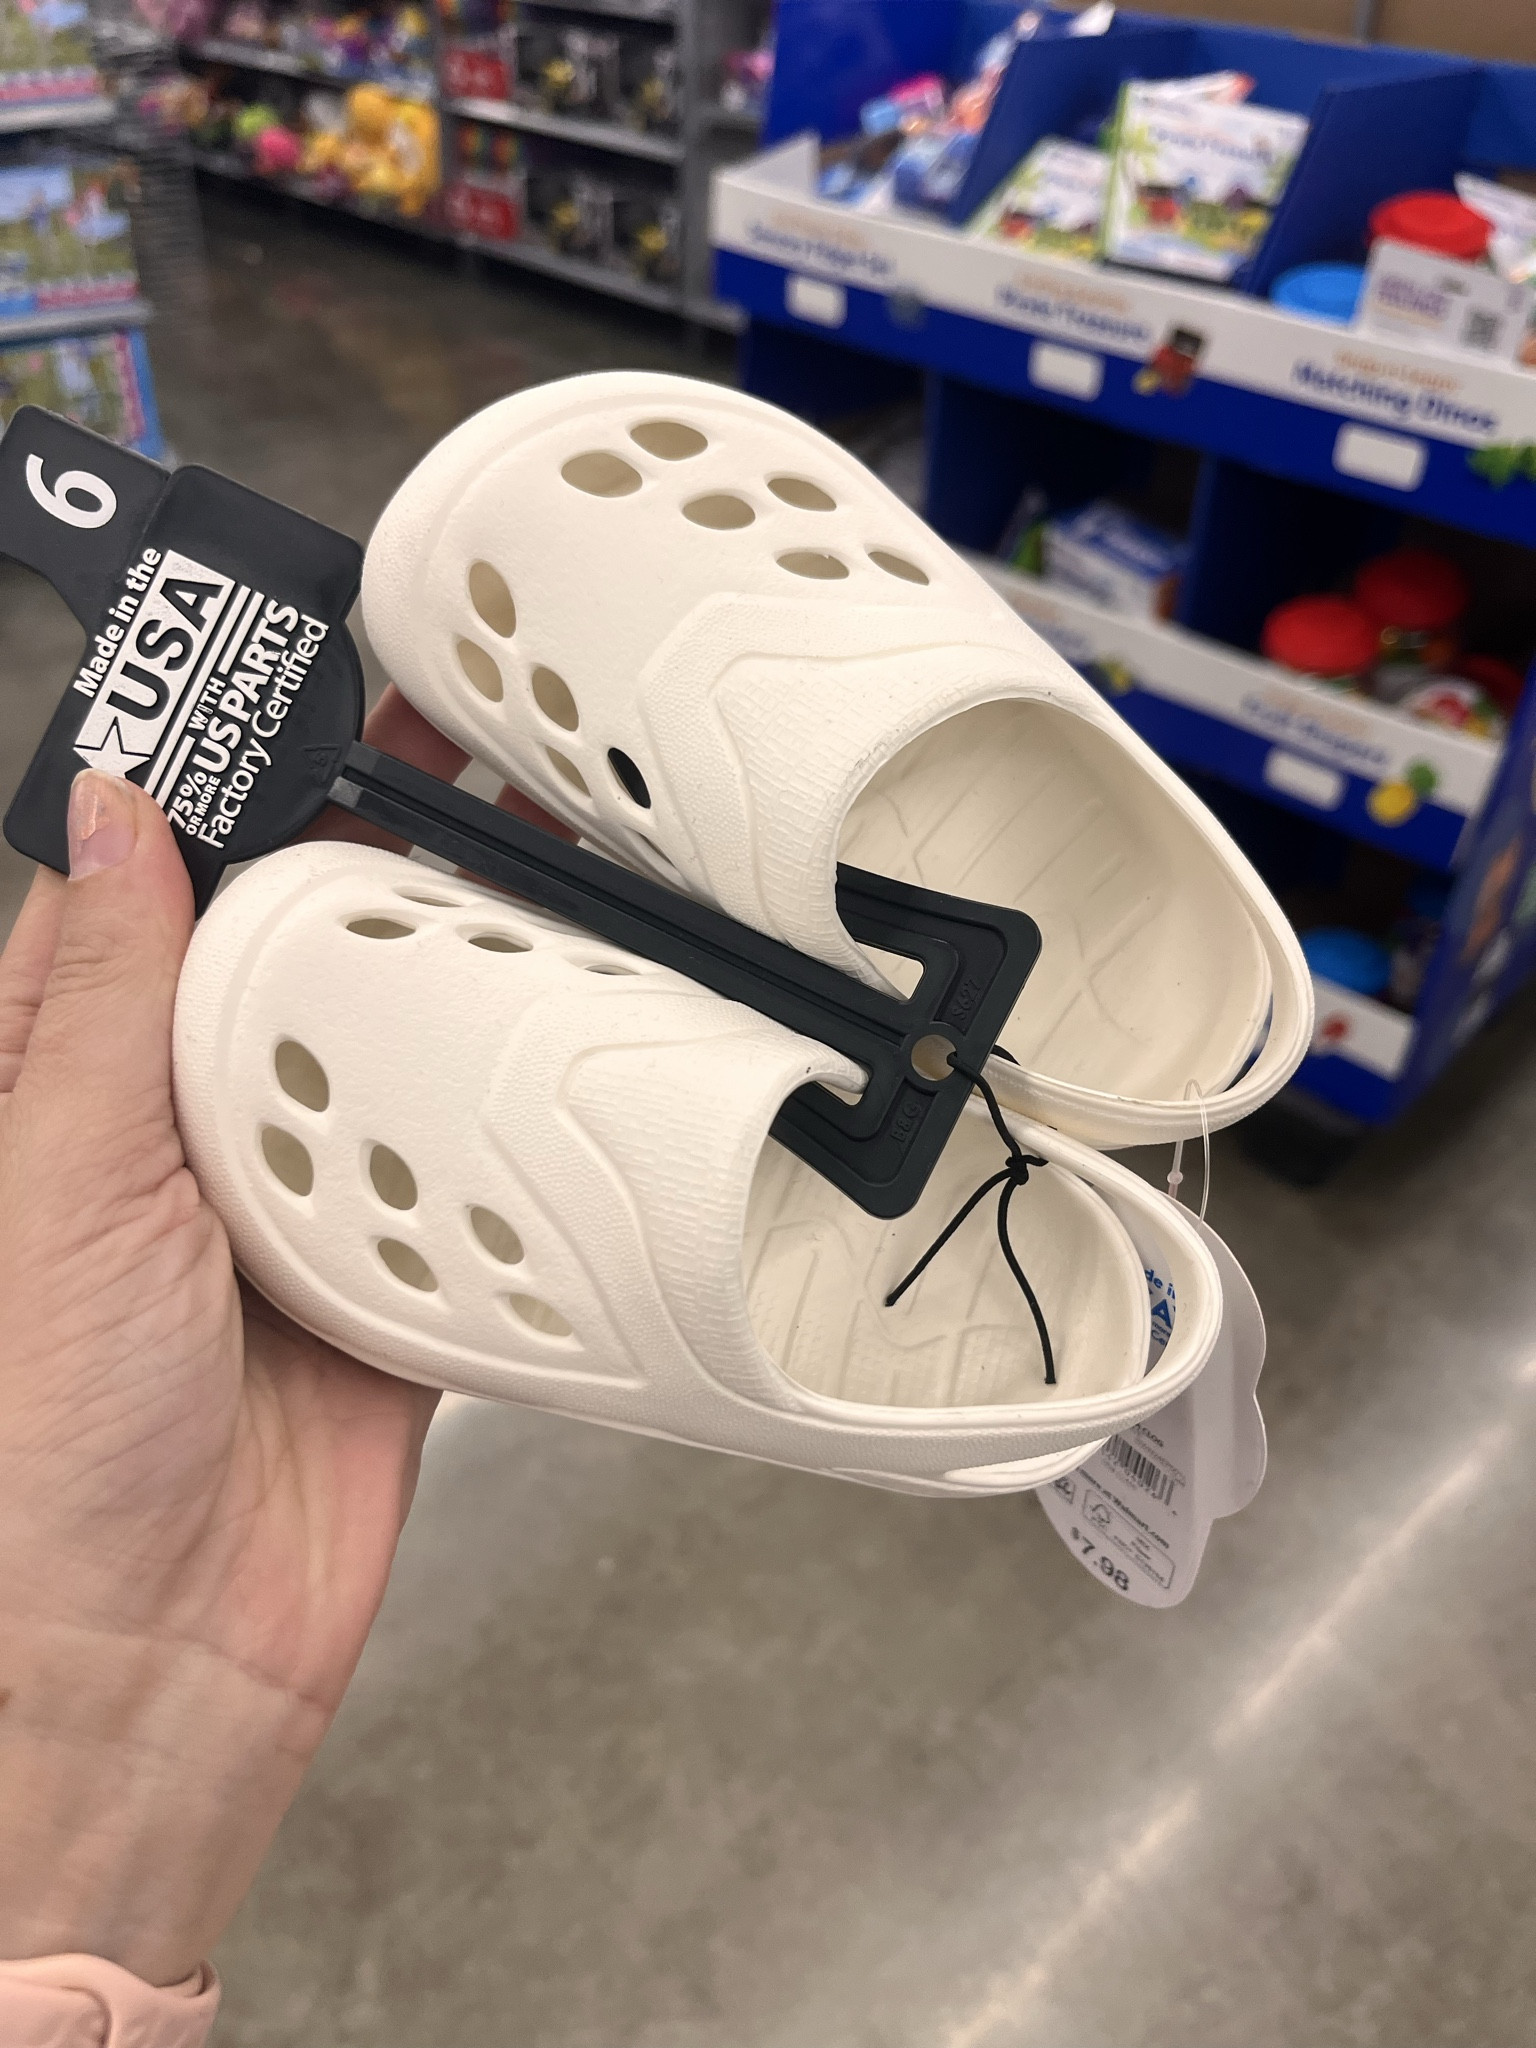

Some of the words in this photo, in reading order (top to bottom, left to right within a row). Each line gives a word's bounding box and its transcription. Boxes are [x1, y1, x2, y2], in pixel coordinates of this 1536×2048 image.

[25, 453, 118, 529] 6
[73, 624, 124, 697] Made
[108, 595, 139, 623] in
[126, 547, 161, 592] the
[106, 577, 224, 720] USA
[168, 772, 207, 829] 75%
[193, 717, 241, 772] US
[219, 599, 298, 723] PARTS
[188, 677, 227, 731] WITH
[198, 738, 272, 848] Factory
[252, 613, 329, 738] Certified
[186, 815, 202, 835] OR
[194, 776, 221, 816] MORE
[1071, 1527, 1129, 1591] $7.98
